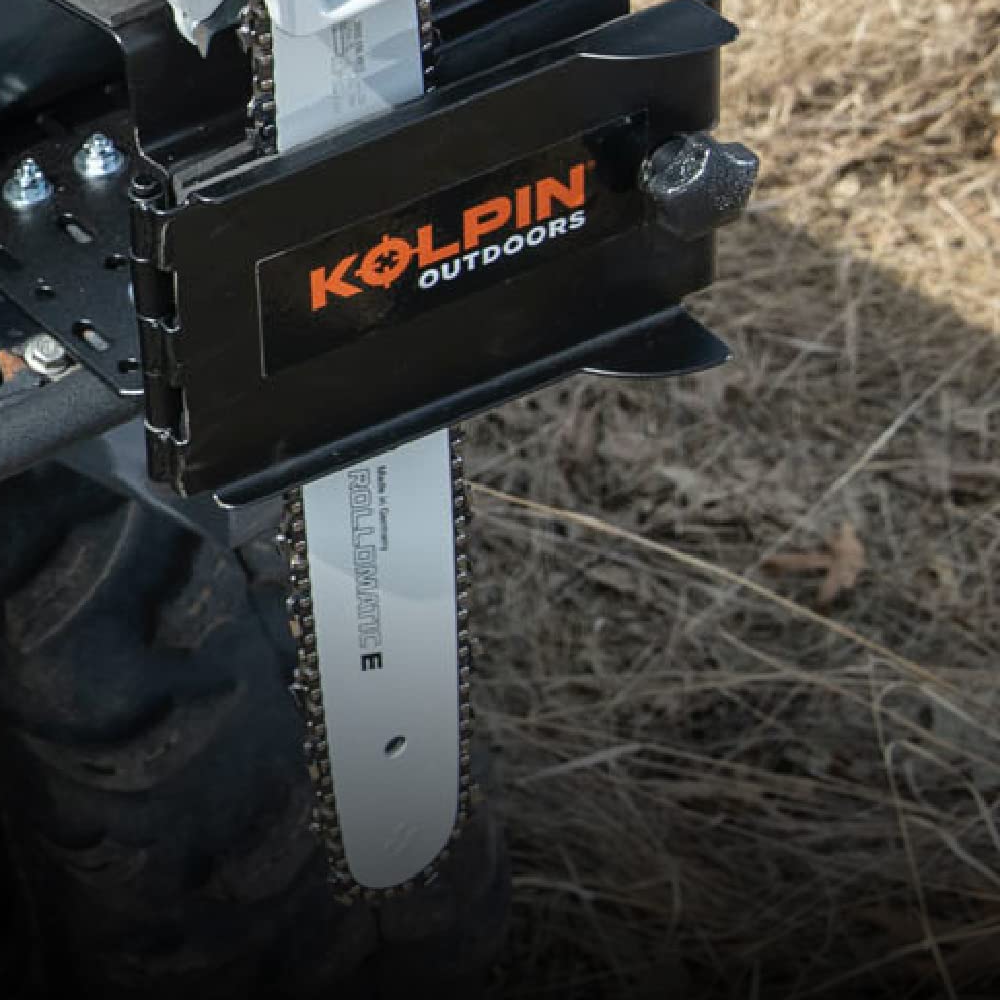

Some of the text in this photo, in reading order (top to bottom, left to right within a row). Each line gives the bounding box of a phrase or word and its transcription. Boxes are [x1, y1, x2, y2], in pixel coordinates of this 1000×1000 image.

[310, 162, 586, 311] KOLPIN
[417, 209, 588, 290] OUTDOORS
[348, 468, 383, 672] ROLLOMATIC E
